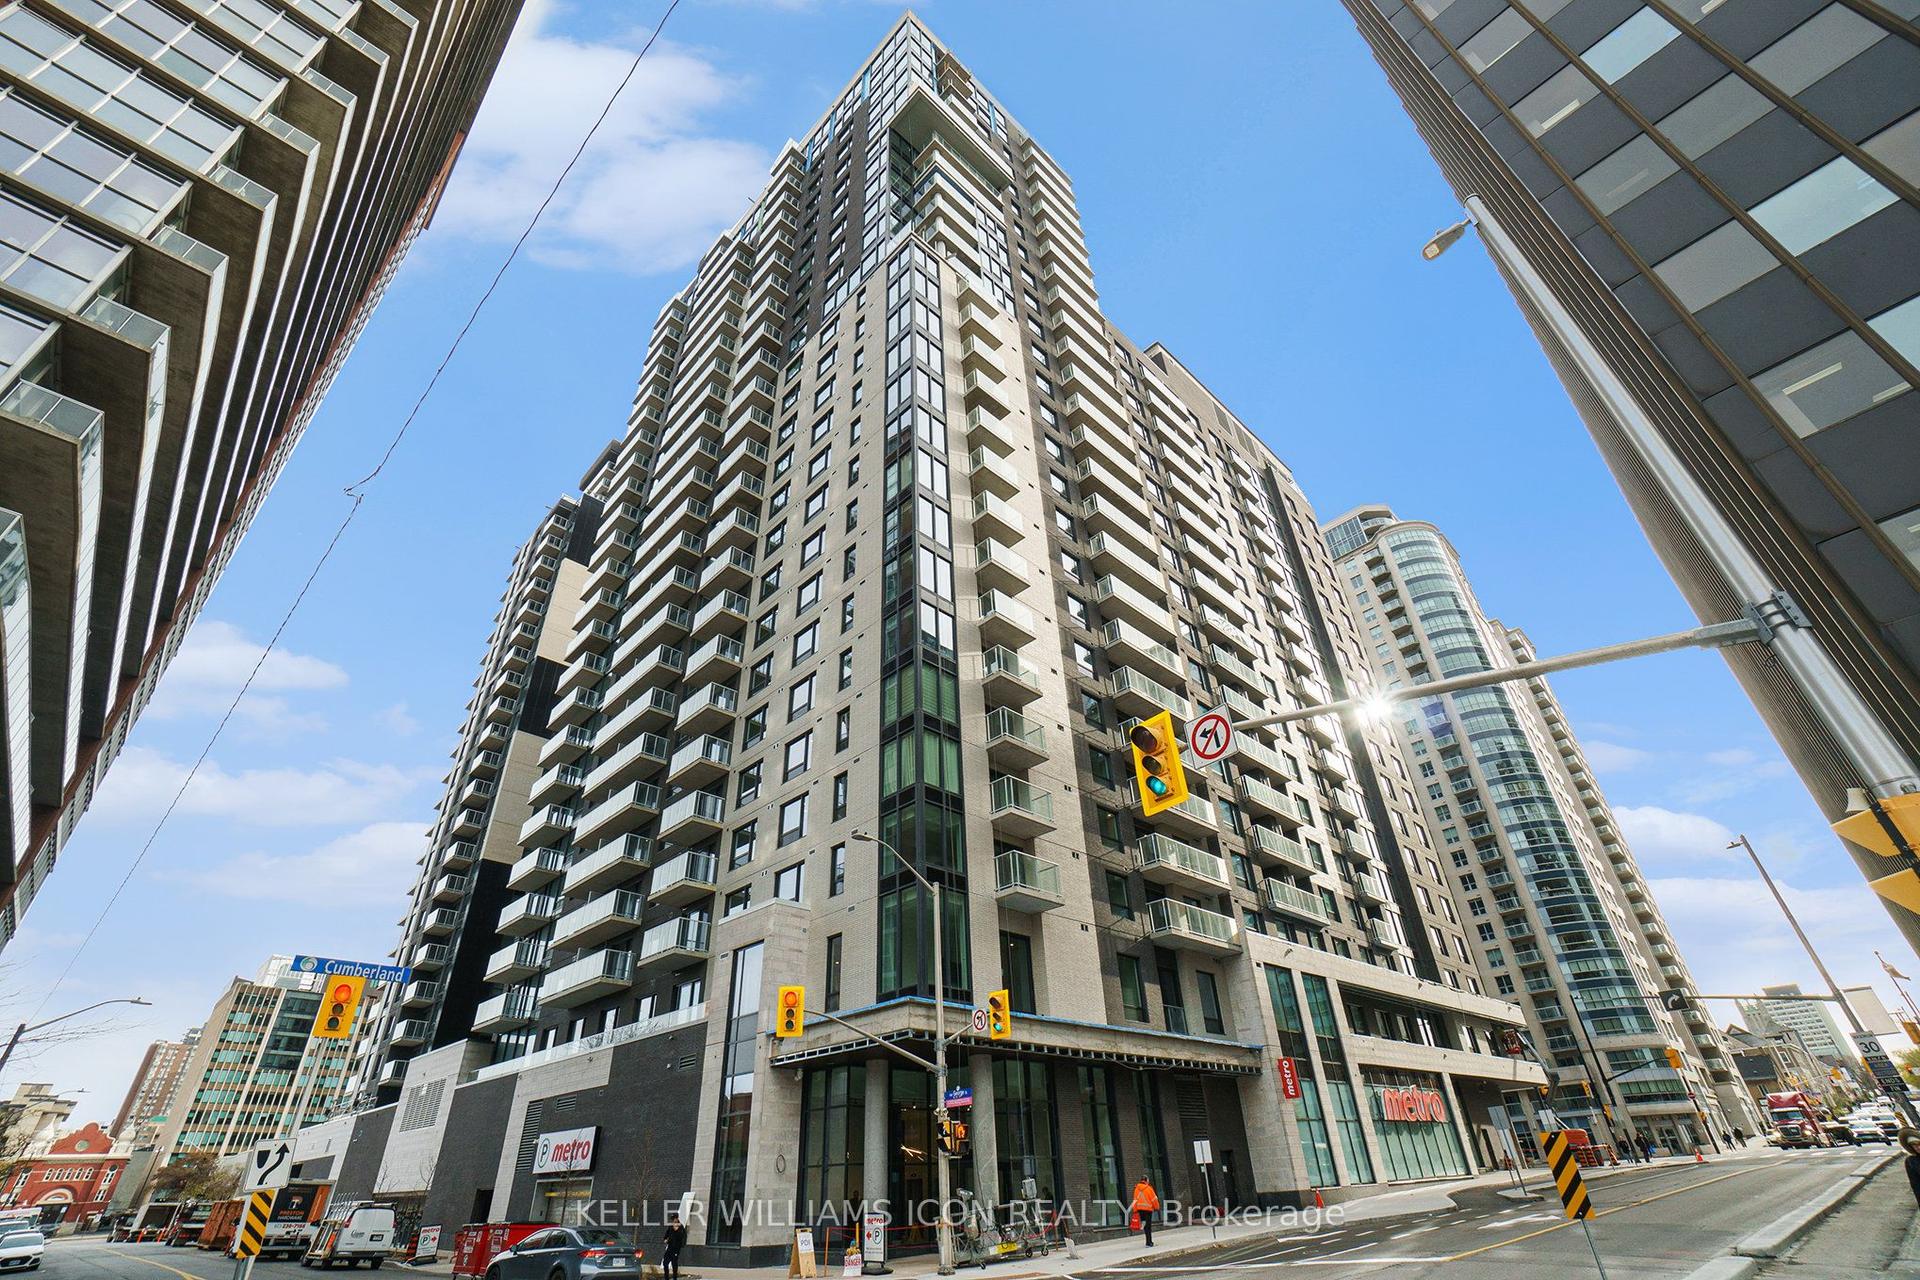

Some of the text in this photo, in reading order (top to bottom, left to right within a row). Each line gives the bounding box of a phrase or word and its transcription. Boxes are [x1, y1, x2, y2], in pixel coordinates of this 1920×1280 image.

[324, 960, 405, 982] Cumberland
[1859, 1041, 1880, 1053] 30
[1282, 1060, 1296, 1096] metro
[1381, 1084, 1448, 1122] metro
[540, 1139, 591, 1162] P metro
[866, 1217, 886, 1225] metro
[845, 1259, 861, 1267] DANGER
